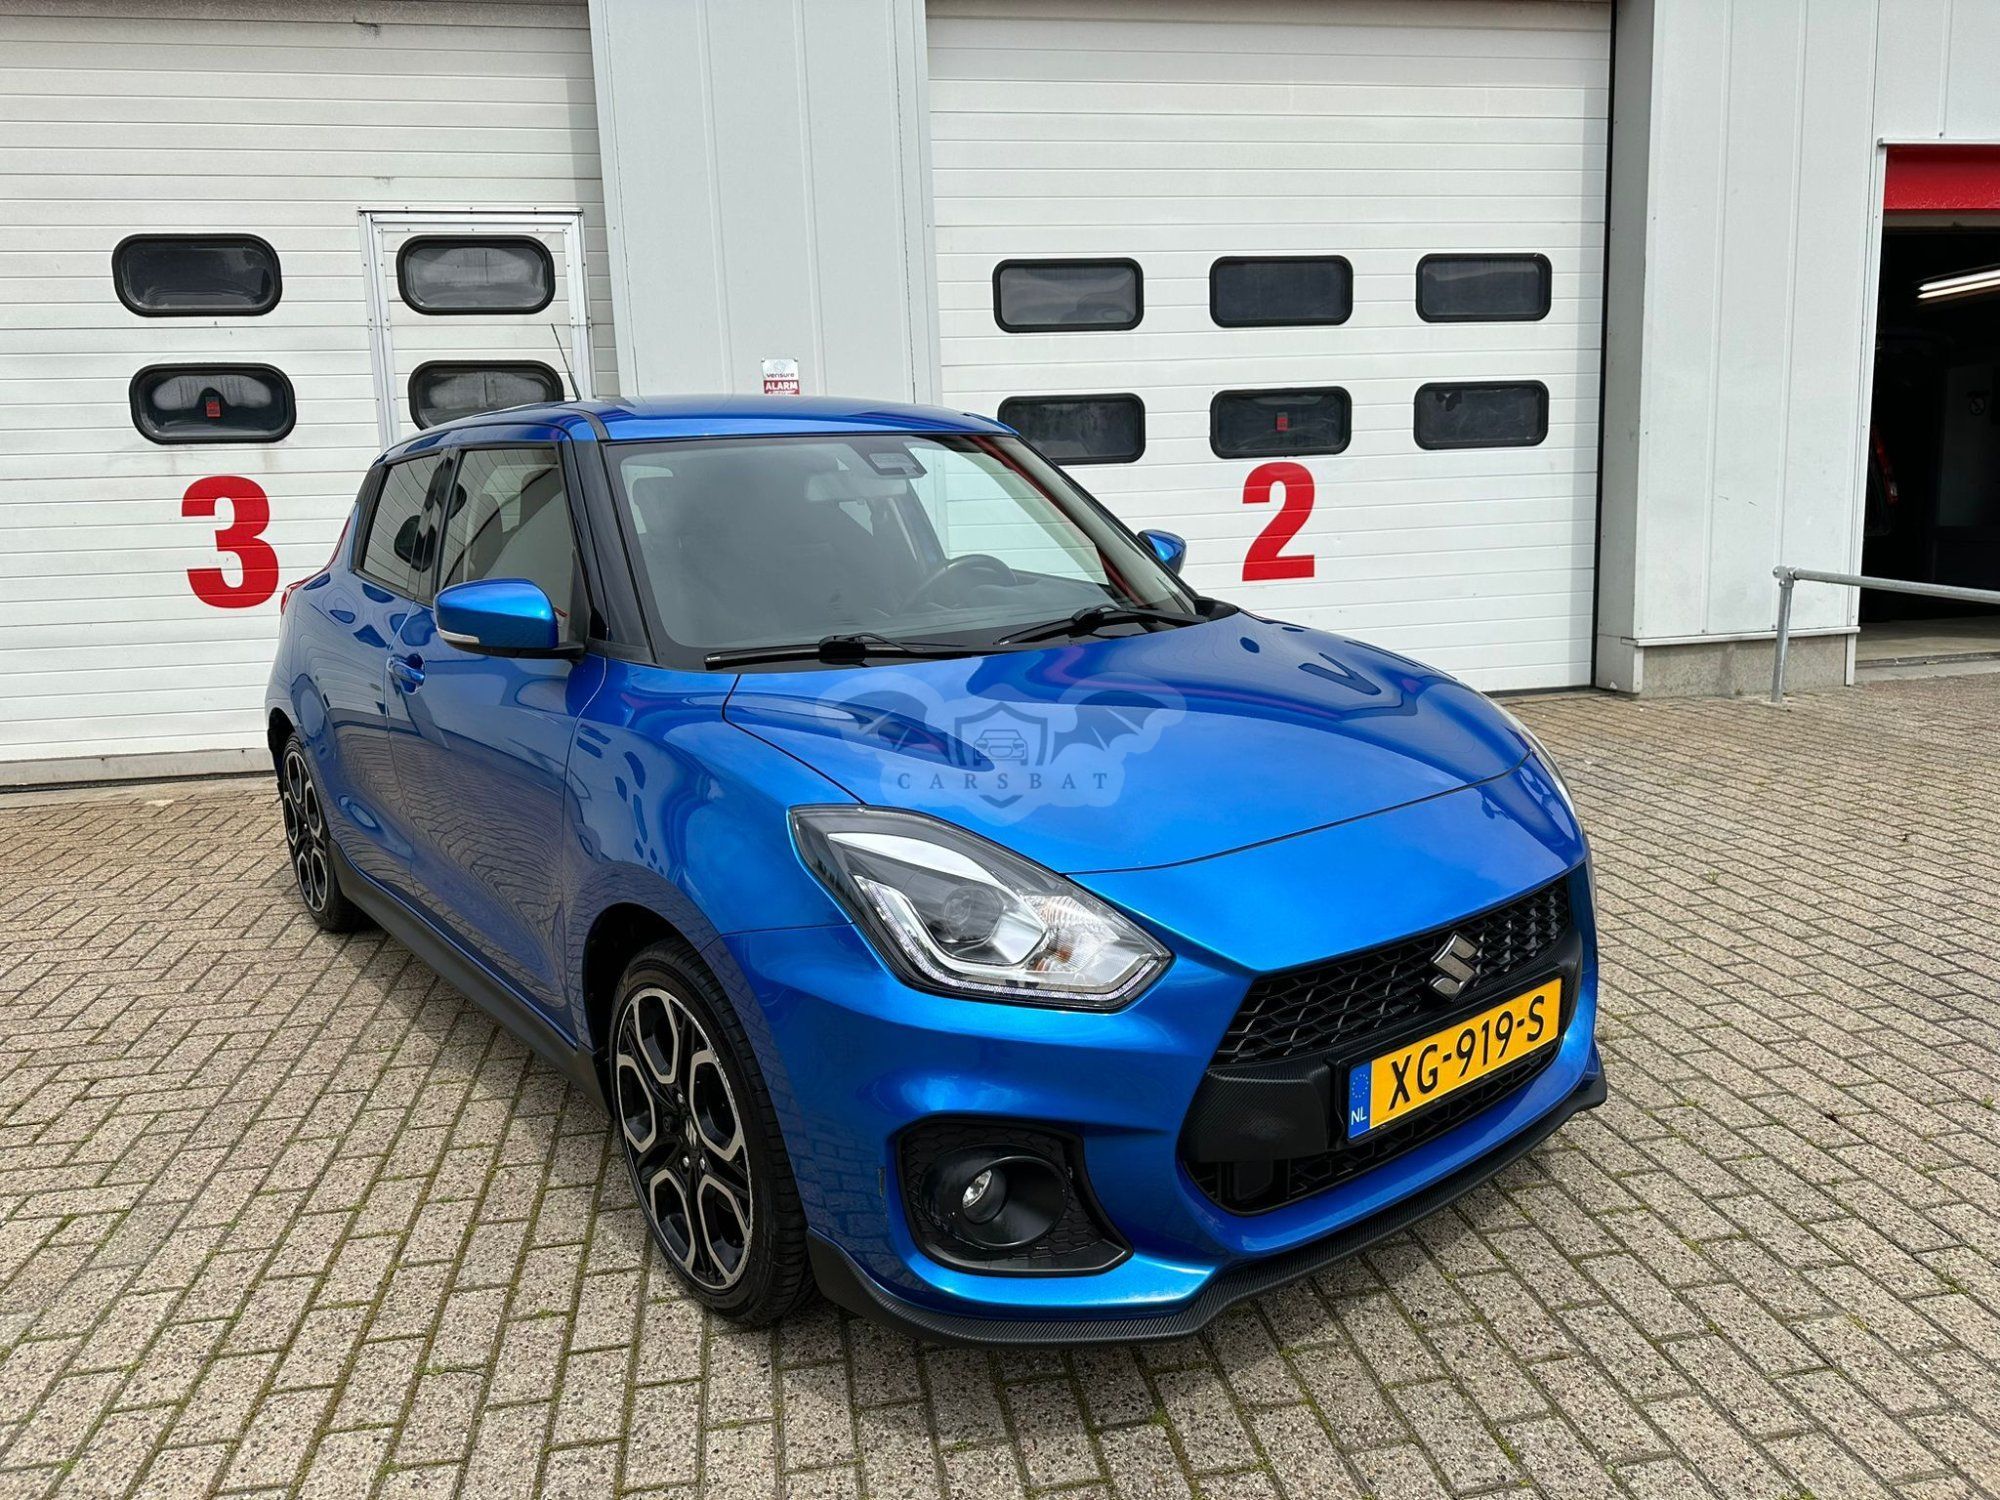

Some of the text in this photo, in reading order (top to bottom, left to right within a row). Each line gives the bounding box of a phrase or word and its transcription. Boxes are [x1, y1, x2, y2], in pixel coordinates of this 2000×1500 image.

[765, 381, 798, 391] ALARM
[181, 475, 279, 609] 3
[1242, 462, 1315, 582] 2
[1388, 995, 1545, 1111] XG-919-S
[1350, 1105, 1367, 1126] NL
